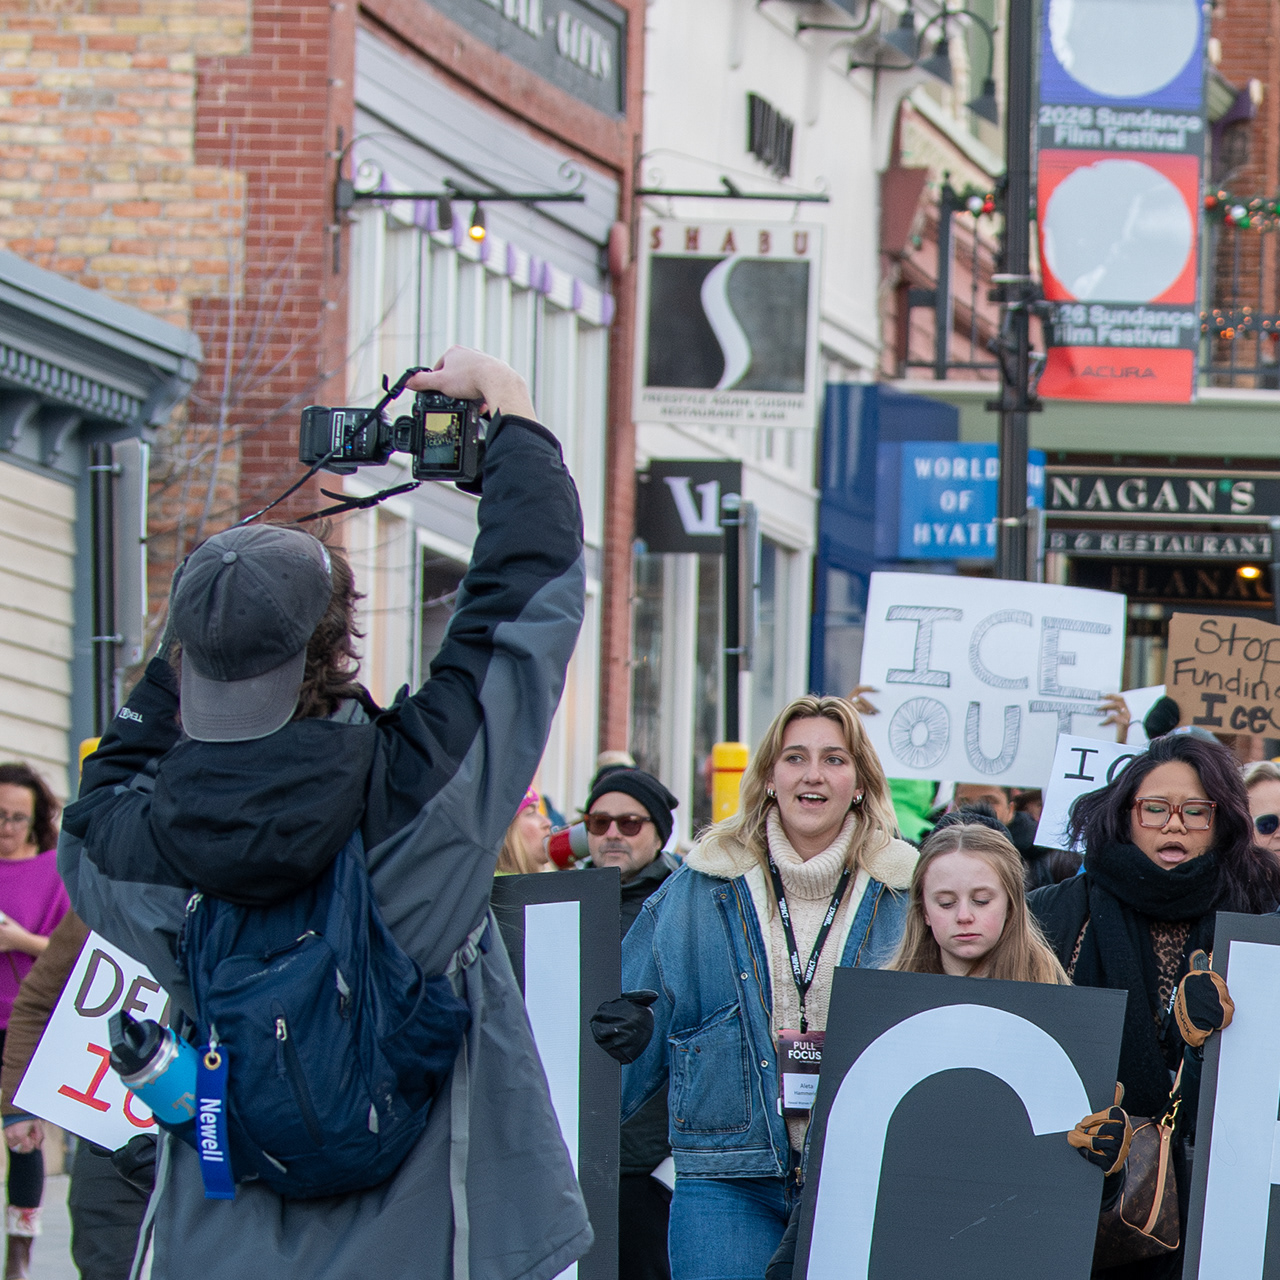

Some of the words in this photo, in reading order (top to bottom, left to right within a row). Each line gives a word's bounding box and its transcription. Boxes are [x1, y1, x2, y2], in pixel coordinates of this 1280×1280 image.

[1038, 105, 1094, 127] 2026
[1095, 106, 1202, 133] Sundance
[1053, 124, 1101, 146] Film
[1103, 127, 1186, 149] Festival
[650, 225, 809, 255] SHABU
[1089, 305, 1196, 329] Sundance
[1096, 325, 1181, 347] Festival
[1080, 365, 1158, 379] ACURA
[913, 457, 998, 479] WORLD
[939, 489, 974, 512] OF
[1100, 534, 1273, 555] RESTAURANT
[885, 604, 1112, 701] ICE
[888, 696, 1108, 775] OUT
[73, 947, 171, 1027] DE
[788, 1050, 822, 1060] FOCUS
[793, 1041, 817, 1051] PULL
[200, 1097, 225, 1162] Newell
